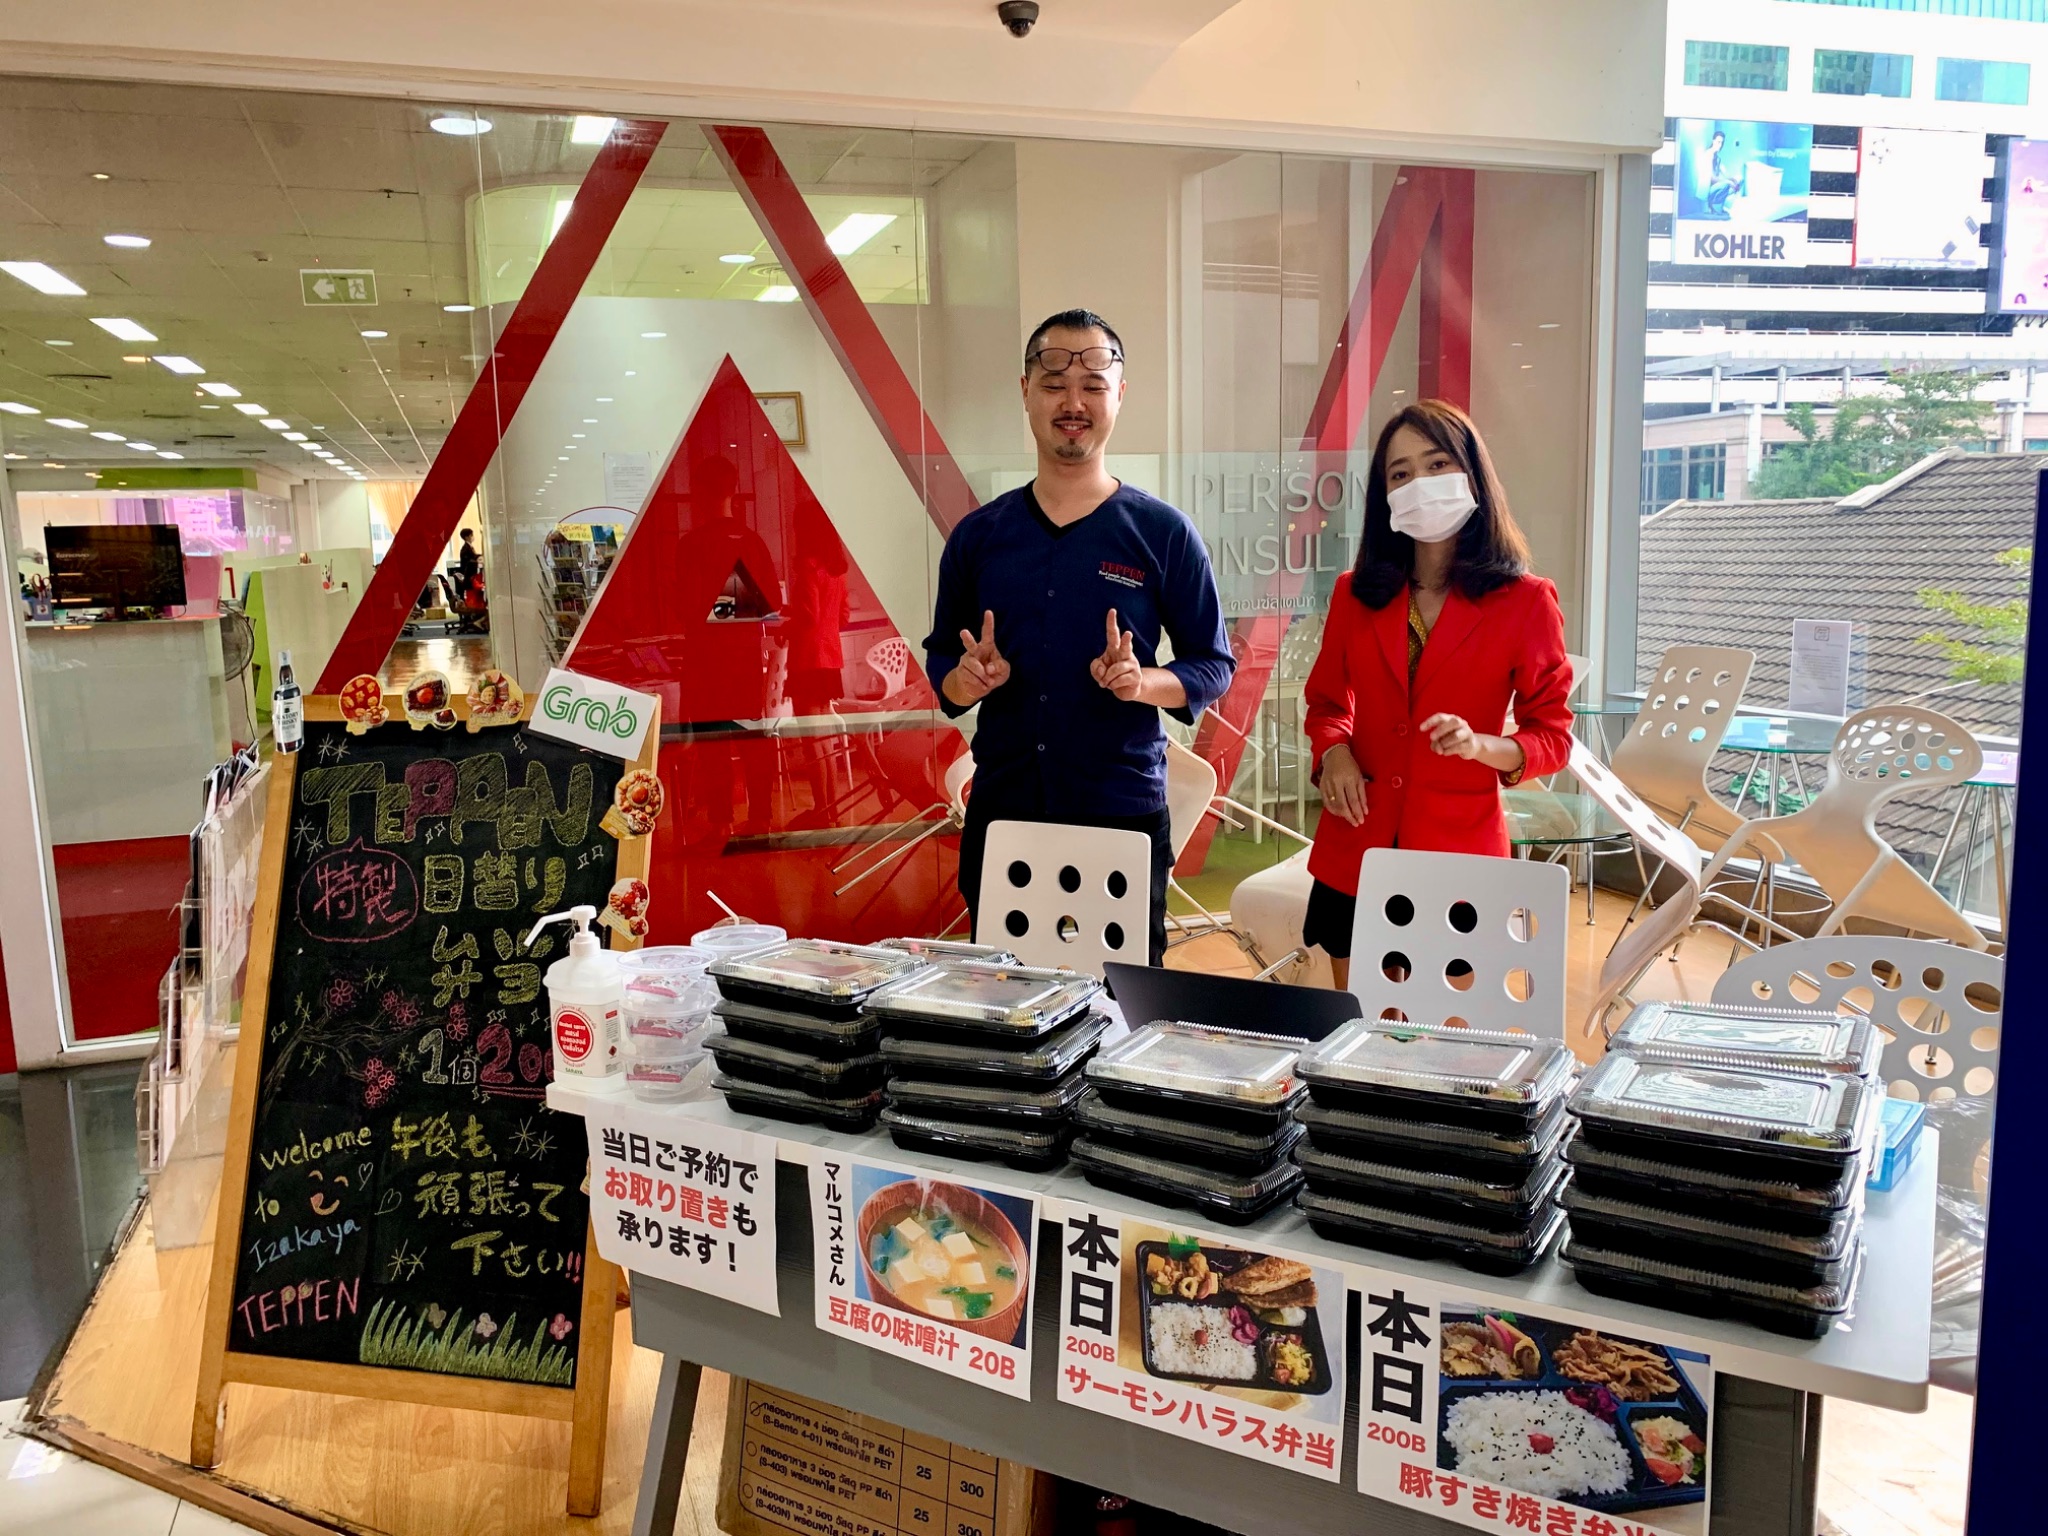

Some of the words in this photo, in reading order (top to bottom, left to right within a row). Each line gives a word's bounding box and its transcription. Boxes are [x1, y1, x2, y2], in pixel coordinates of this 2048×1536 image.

[1694, 233, 1785, 260] KOHLER
[1100, 561, 1146, 581] TEPPEN
[543, 686, 637, 738] Grab
[313, 859, 410, 925] 特製
[423, 851, 567, 914] 日替り
[431, 925, 554, 1008] 弁当
[602, 1127, 759, 1194] 当日ご予約で
[254, 1191, 280, 1223] to
[414, 1170, 565, 1222] 頑張って
[603, 1166, 758, 1236] お取り置きも
[248, 1219, 361, 1273] Izakaya
[824, 1162, 846, 1287] マルコメさん
[1066, 1213, 1120, 1337] 本日
[237, 1277, 361, 1338] TEPPEN
[828, 1295, 960, 1361] 豆腐の味噌汁
[968, 1346, 1016, 1381] 20B
[1066, 1335, 1116, 1363] 200B
[1366, 1288, 1431, 1424] 本日
[762, 1413, 799, 1436] (S-Bento
[801, 1430, 823, 1447] 4-01)
[874, 1458, 893, 1471] PET
[813, 1421, 819, 1429] 4
[862, 1439, 876, 1451] PP
[1064, 1363, 1336, 1471] サーモンハラス弁当
[1366, 1422, 1427, 1454] 200B
[759, 1456, 788, 1477] (S-403)
[838, 1487, 857, 1501] PET
[810, 1464, 816, 1473] 3
[859, 1482, 873, 1493] PP
[916, 1465, 932, 1480] 25
[959, 1480, 985, 1498] 300
[755, 1498, 790, 1521] (S-403N)
[806, 1505, 812, 1515] 3
[856, 1524, 869, 1535] PP
[913, 1508, 930, 1523] 25
[957, 1523, 982, 1536] 300
